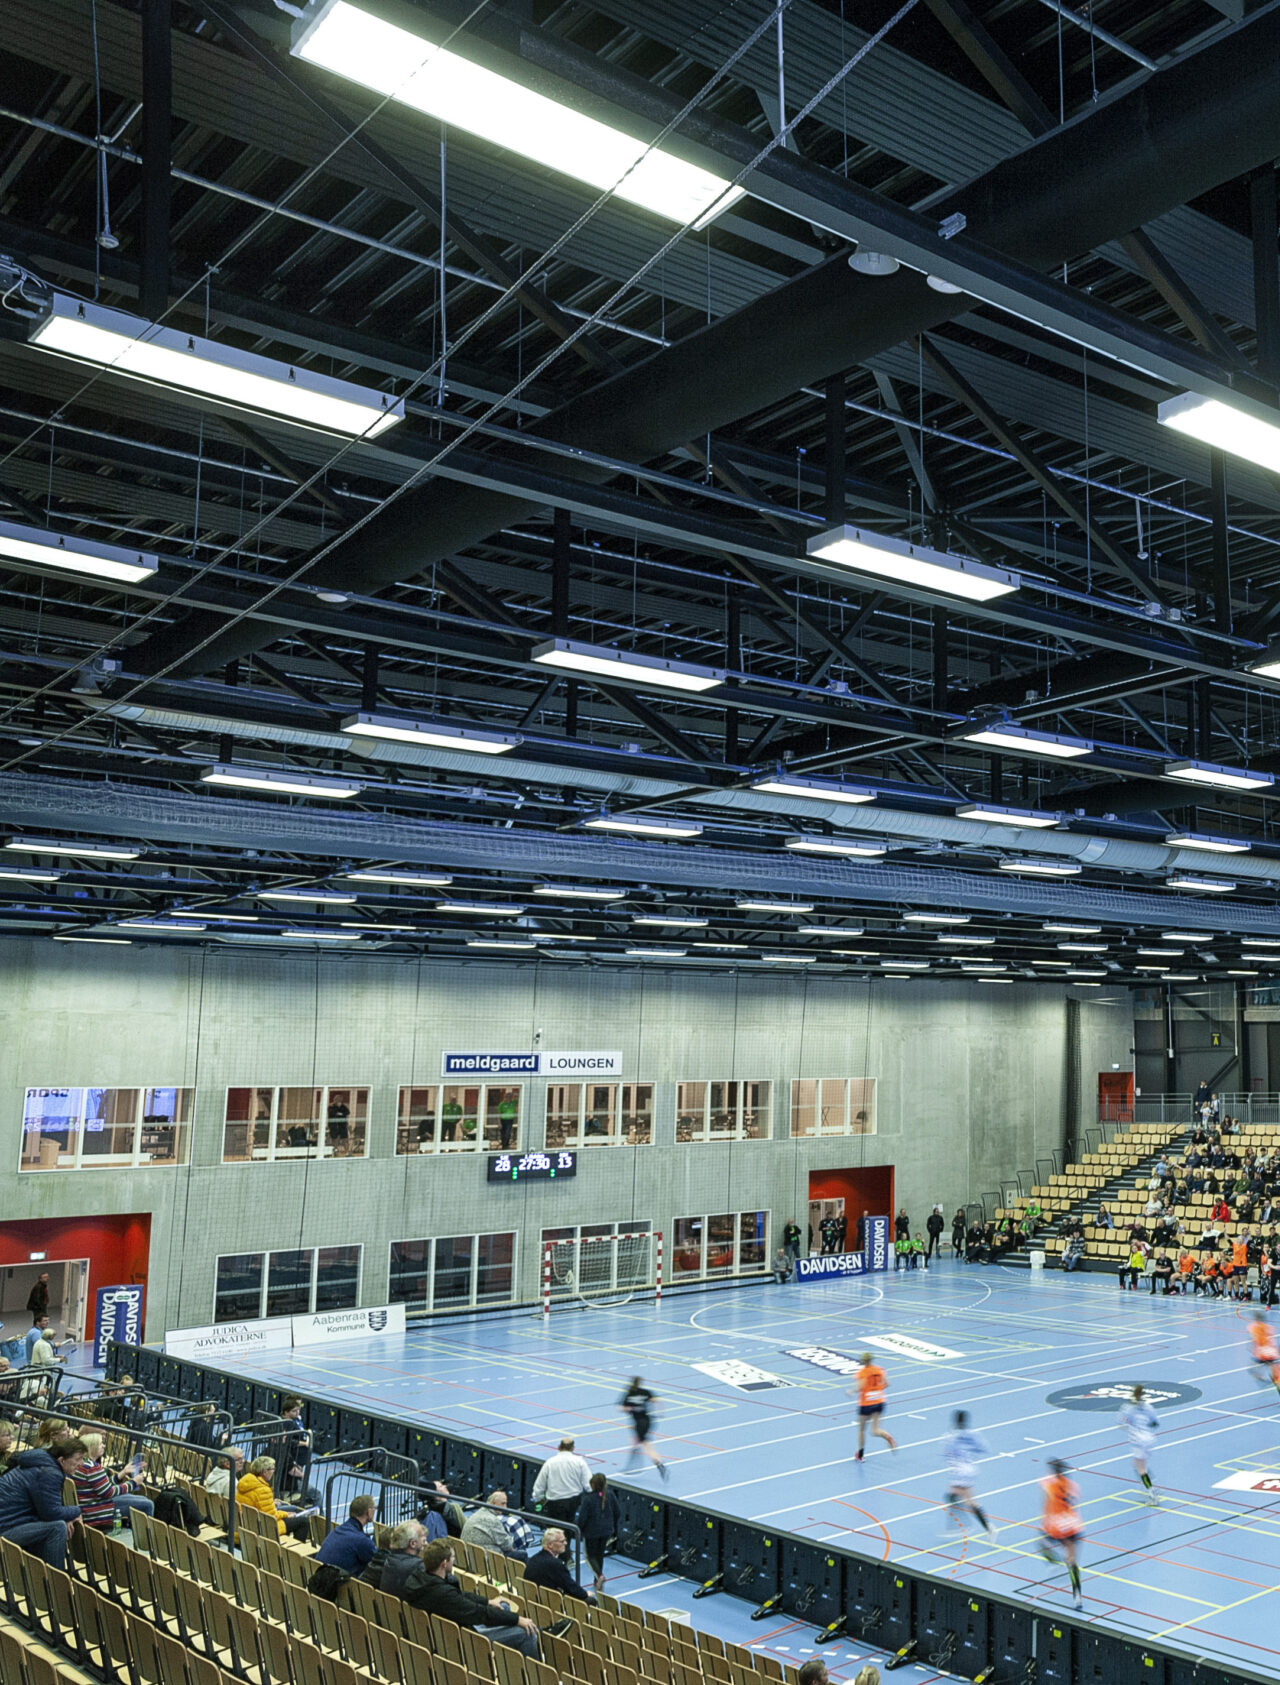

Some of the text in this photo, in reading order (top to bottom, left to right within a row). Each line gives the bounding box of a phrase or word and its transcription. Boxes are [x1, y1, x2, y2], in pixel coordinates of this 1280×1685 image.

[1213, 1036, 1219, 1046] A
[450, 1055, 614, 1071] meldgaard LOUNGEN
[494, 1160, 511, 1172] 28
[518, 1158, 551, 1170] 27:30
[557, 1156, 573, 1168] 13
[873, 1219, 885, 1269] DAVIDSEN
[800, 1253, 863, 1275] DAVIDSEN
[125, 1290, 140, 1347] DAVIDS
[312, 1313, 366, 1326] Aabenraa
[98, 1292, 117, 1363] DAVIDSEN
[212, 1325, 249, 1336] JUDICA
[327, 1322, 365, 1334] Kommune
[194, 1331, 267, 1348] ADVOKATERNE
